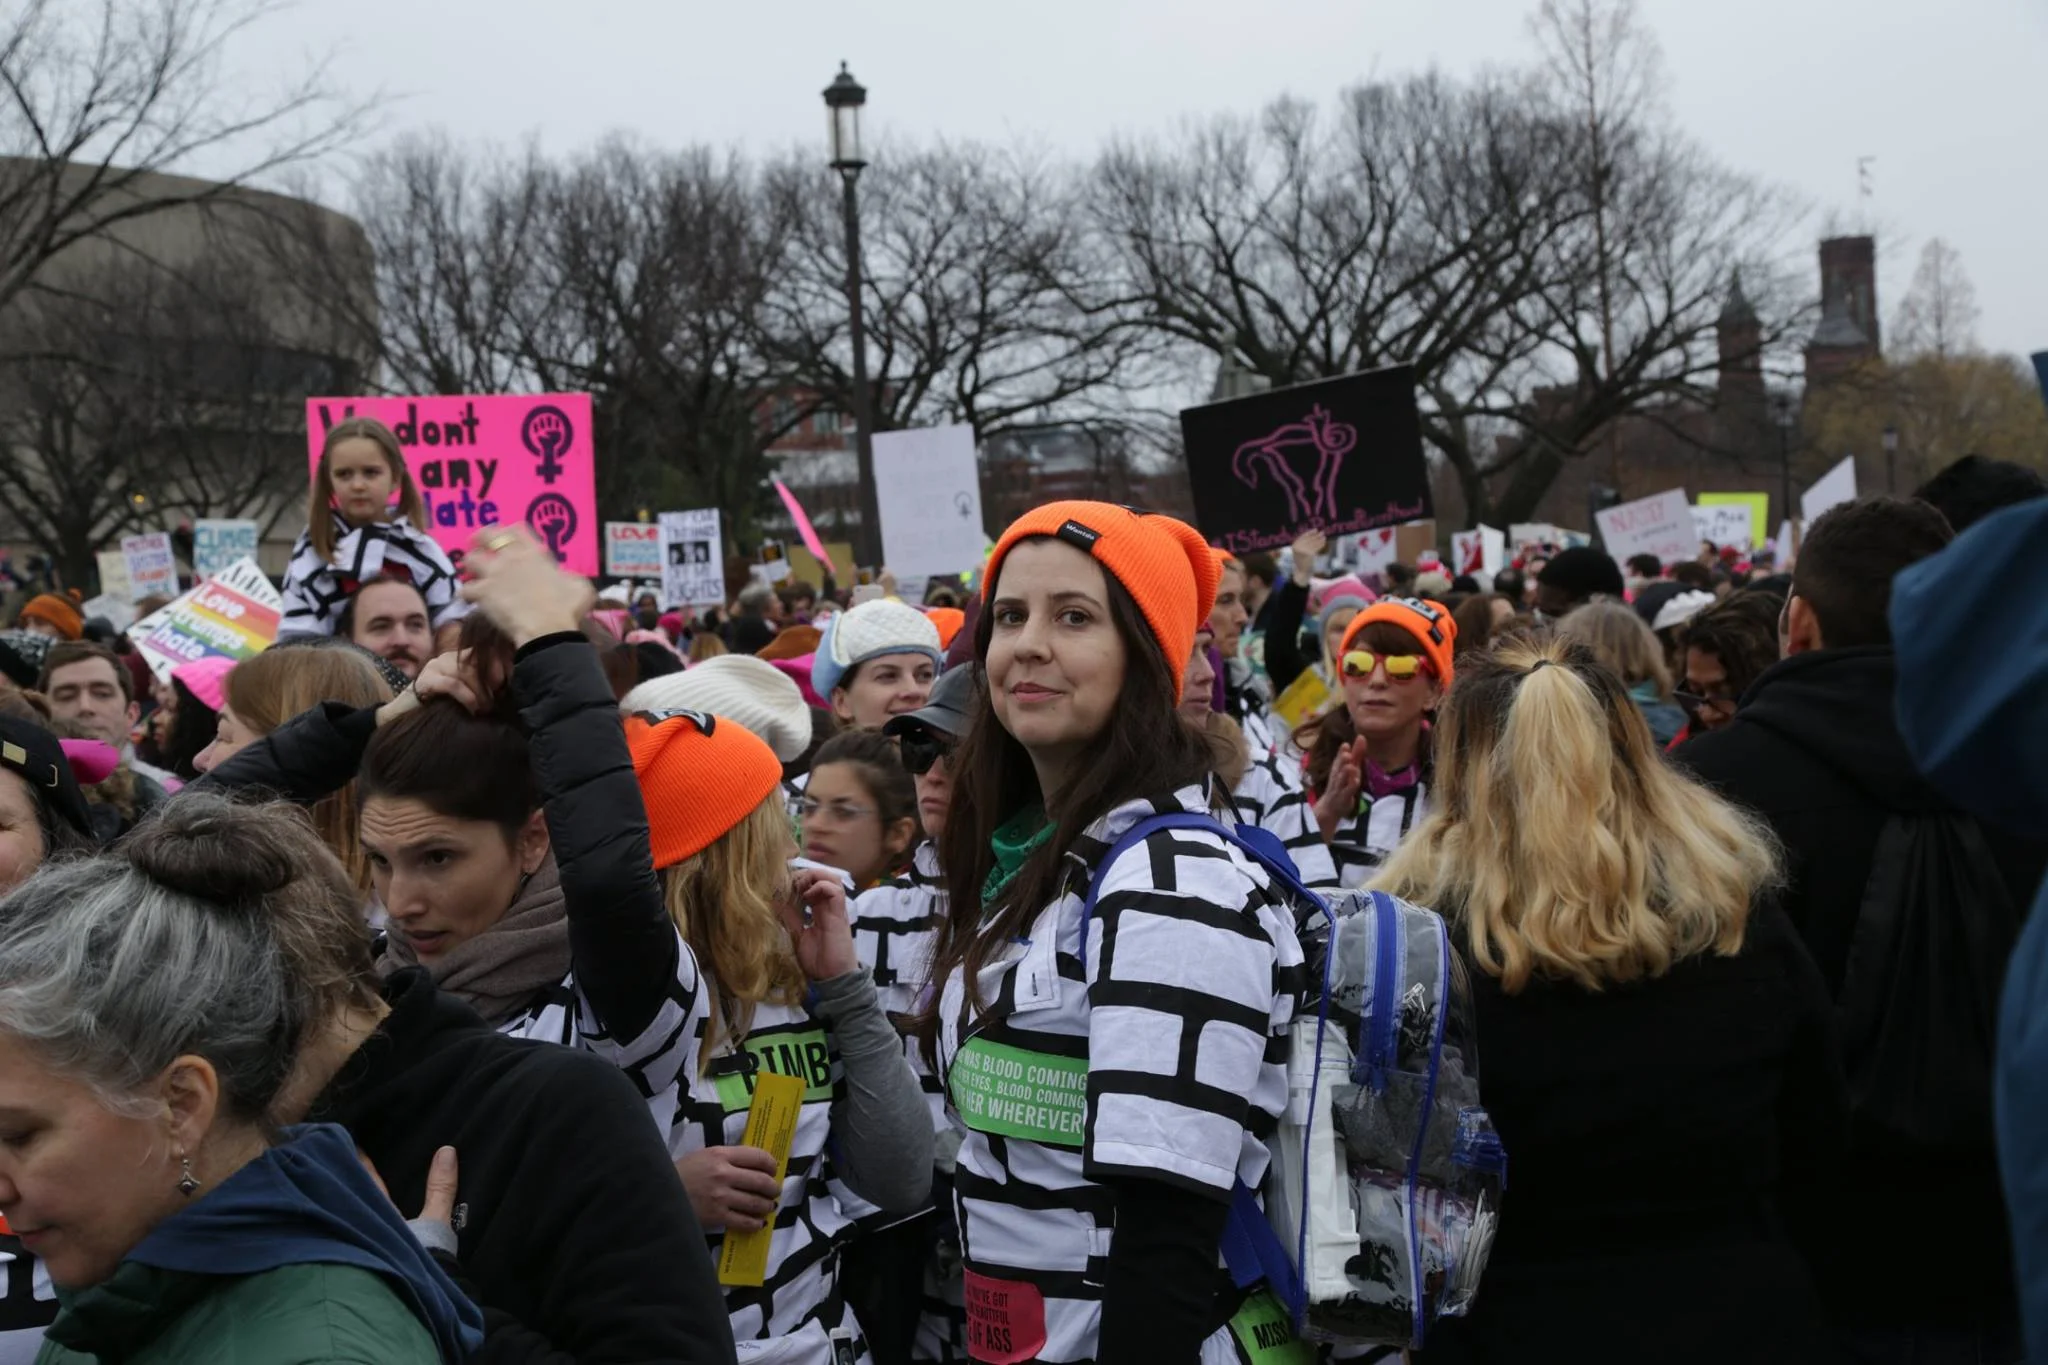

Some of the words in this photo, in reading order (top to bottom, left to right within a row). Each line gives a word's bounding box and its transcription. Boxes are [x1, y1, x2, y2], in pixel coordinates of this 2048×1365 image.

[420, 458, 498, 499] any
[195, 582, 246, 620] Love
[151, 622, 206, 661] hate
[174, 604, 248, 650] trumps
[970, 1071, 993, 1093] EYES,
[996, 1080, 1032, 1101] BLOOD
[1036, 1087, 1087, 1110] COMING
[982, 1055, 1023, 1080] BLOOD
[1027, 1064, 1087, 1092] COMING
[966, 1088, 985, 1116] HER
[988, 1096, 1083, 1134] WHEREVER
[992, 1291, 1009, 1308] GOT
[986, 1323, 1013, 1354] ASS
[1252, 1320, 1288, 1350] MISS
